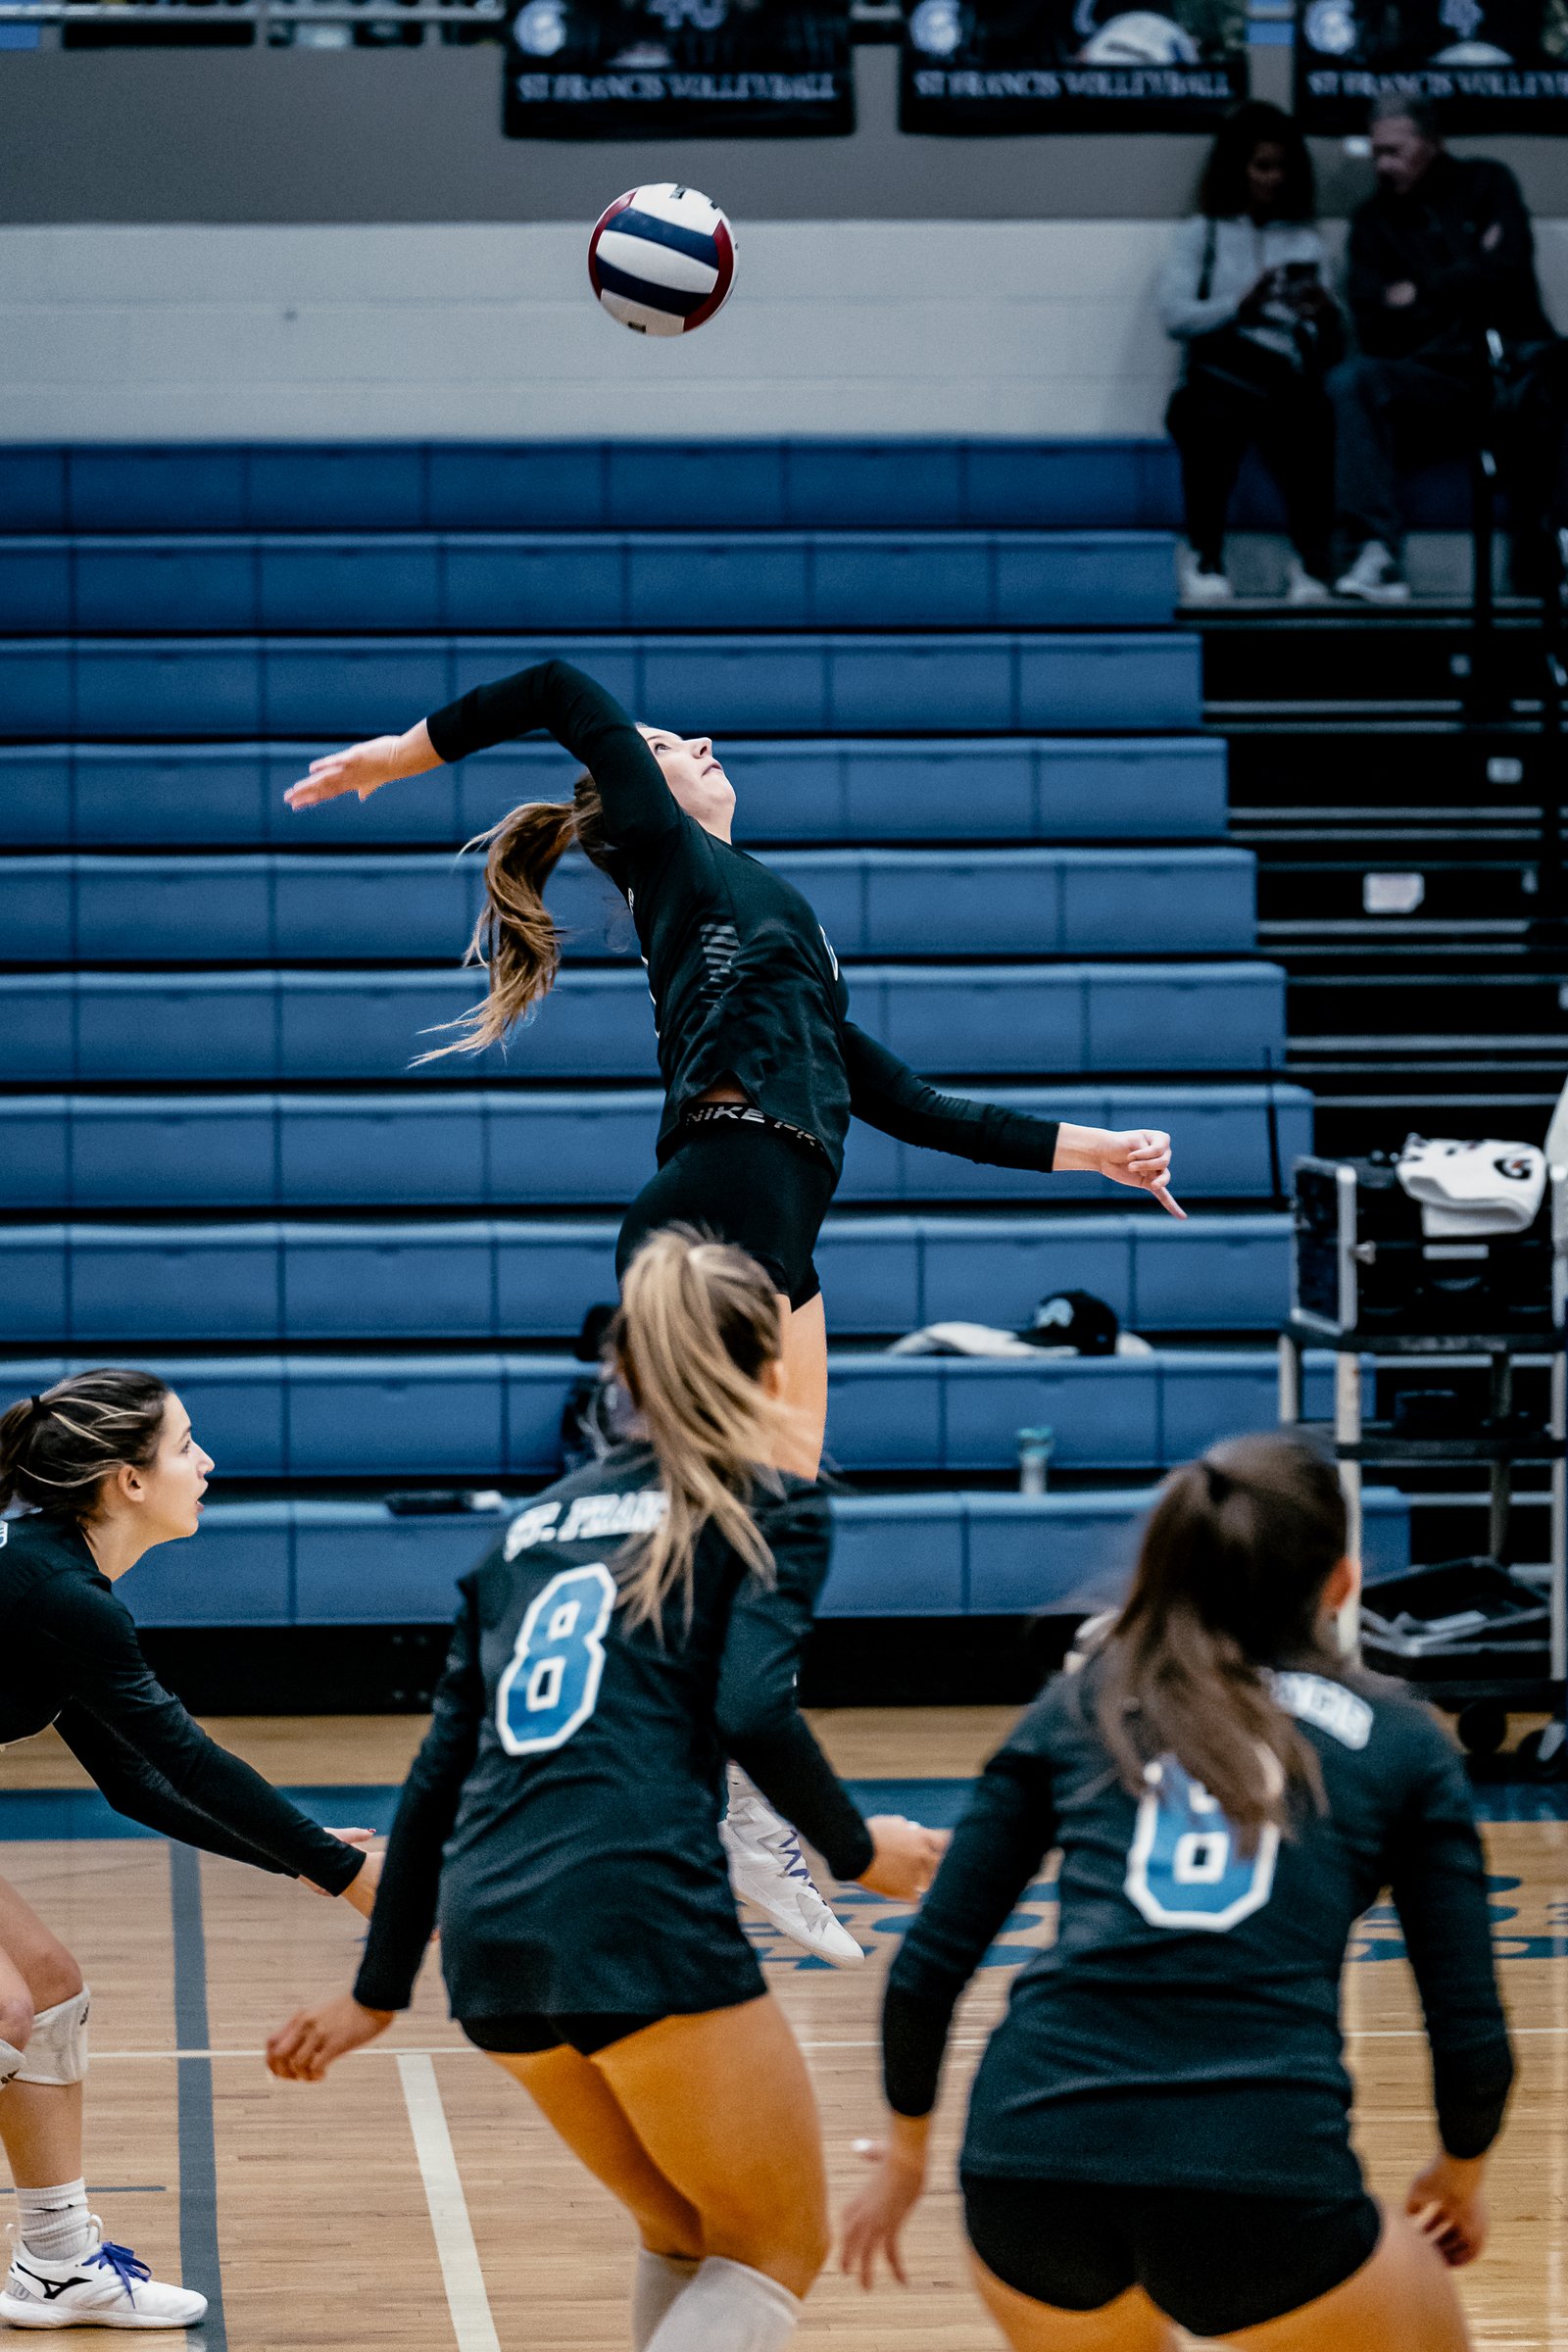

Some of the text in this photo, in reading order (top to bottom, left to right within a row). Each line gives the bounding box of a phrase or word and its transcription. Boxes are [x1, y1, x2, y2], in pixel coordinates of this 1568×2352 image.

[686, 1105, 765, 1125] NIKE
[496, 1562, 617, 1757] 8
[1124, 1742, 1286, 1933] 6
